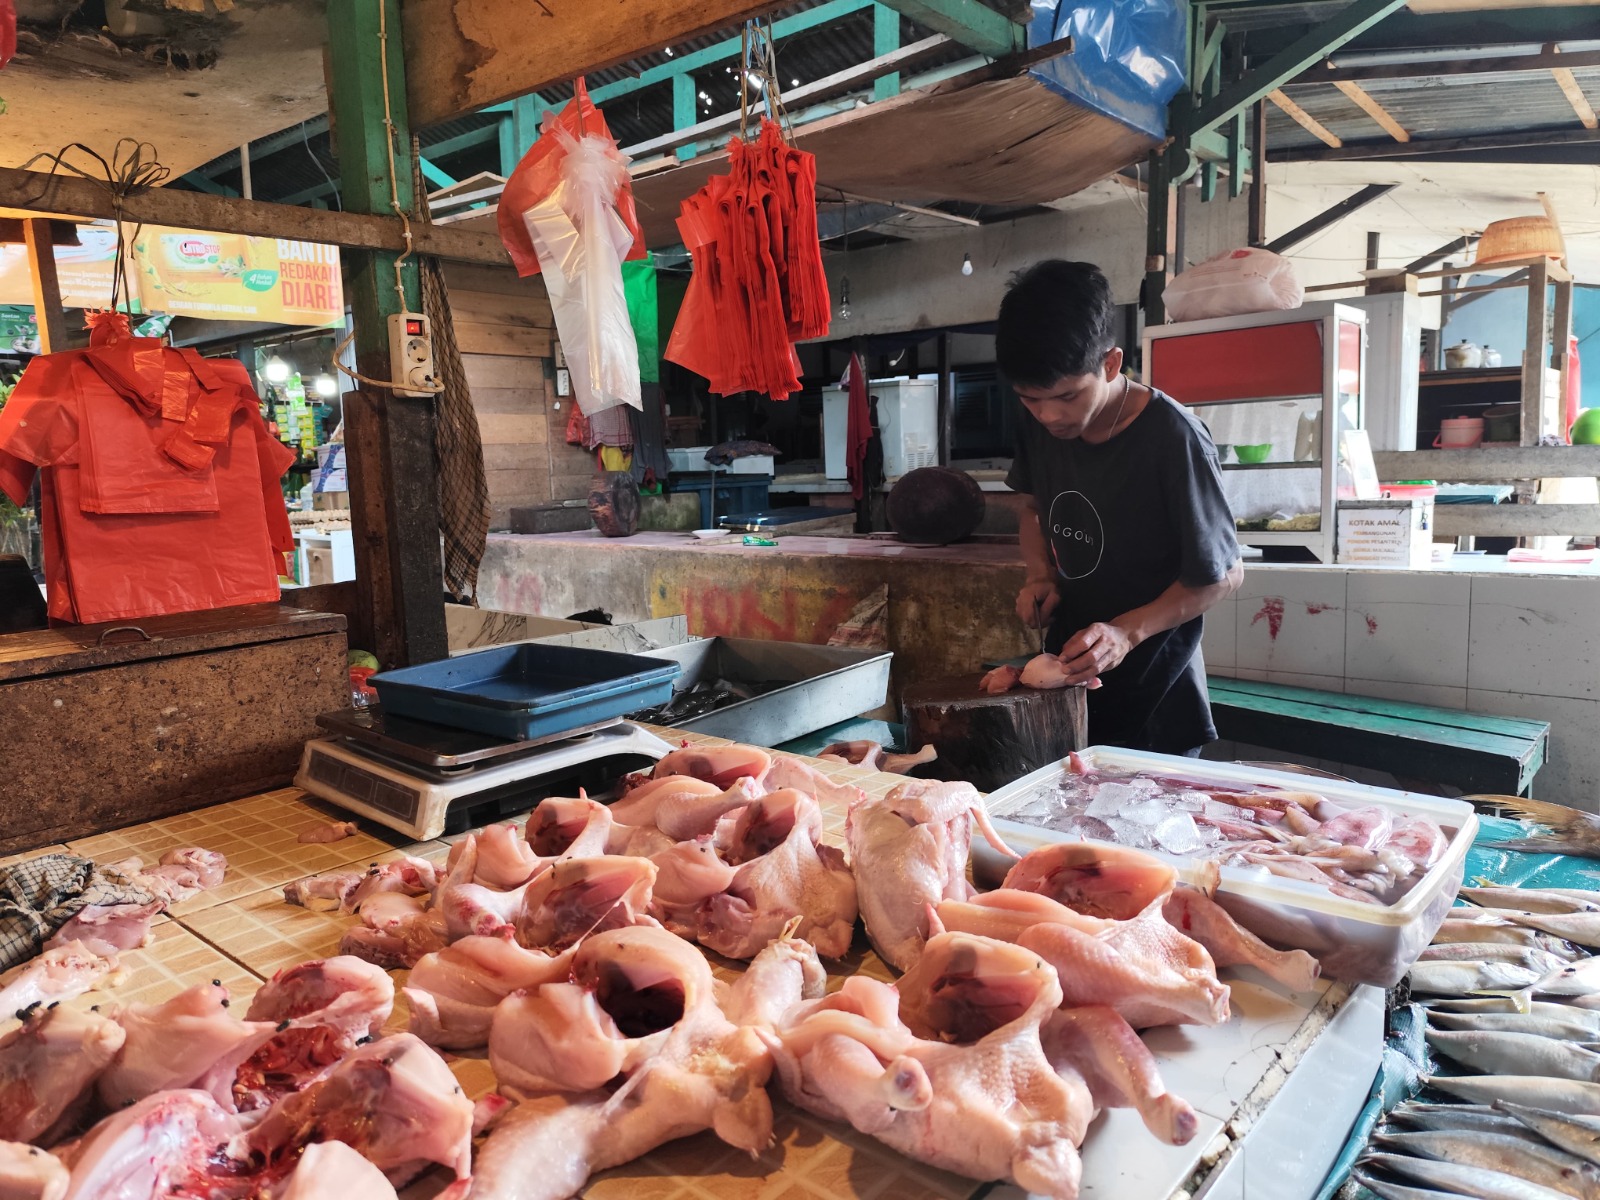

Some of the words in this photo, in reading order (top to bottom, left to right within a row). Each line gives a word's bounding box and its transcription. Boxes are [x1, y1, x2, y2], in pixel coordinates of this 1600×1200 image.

[276, 238, 337, 265] BANTU
[279, 262, 338, 283] REDAKAN
[281, 281, 340, 310] DIARE
